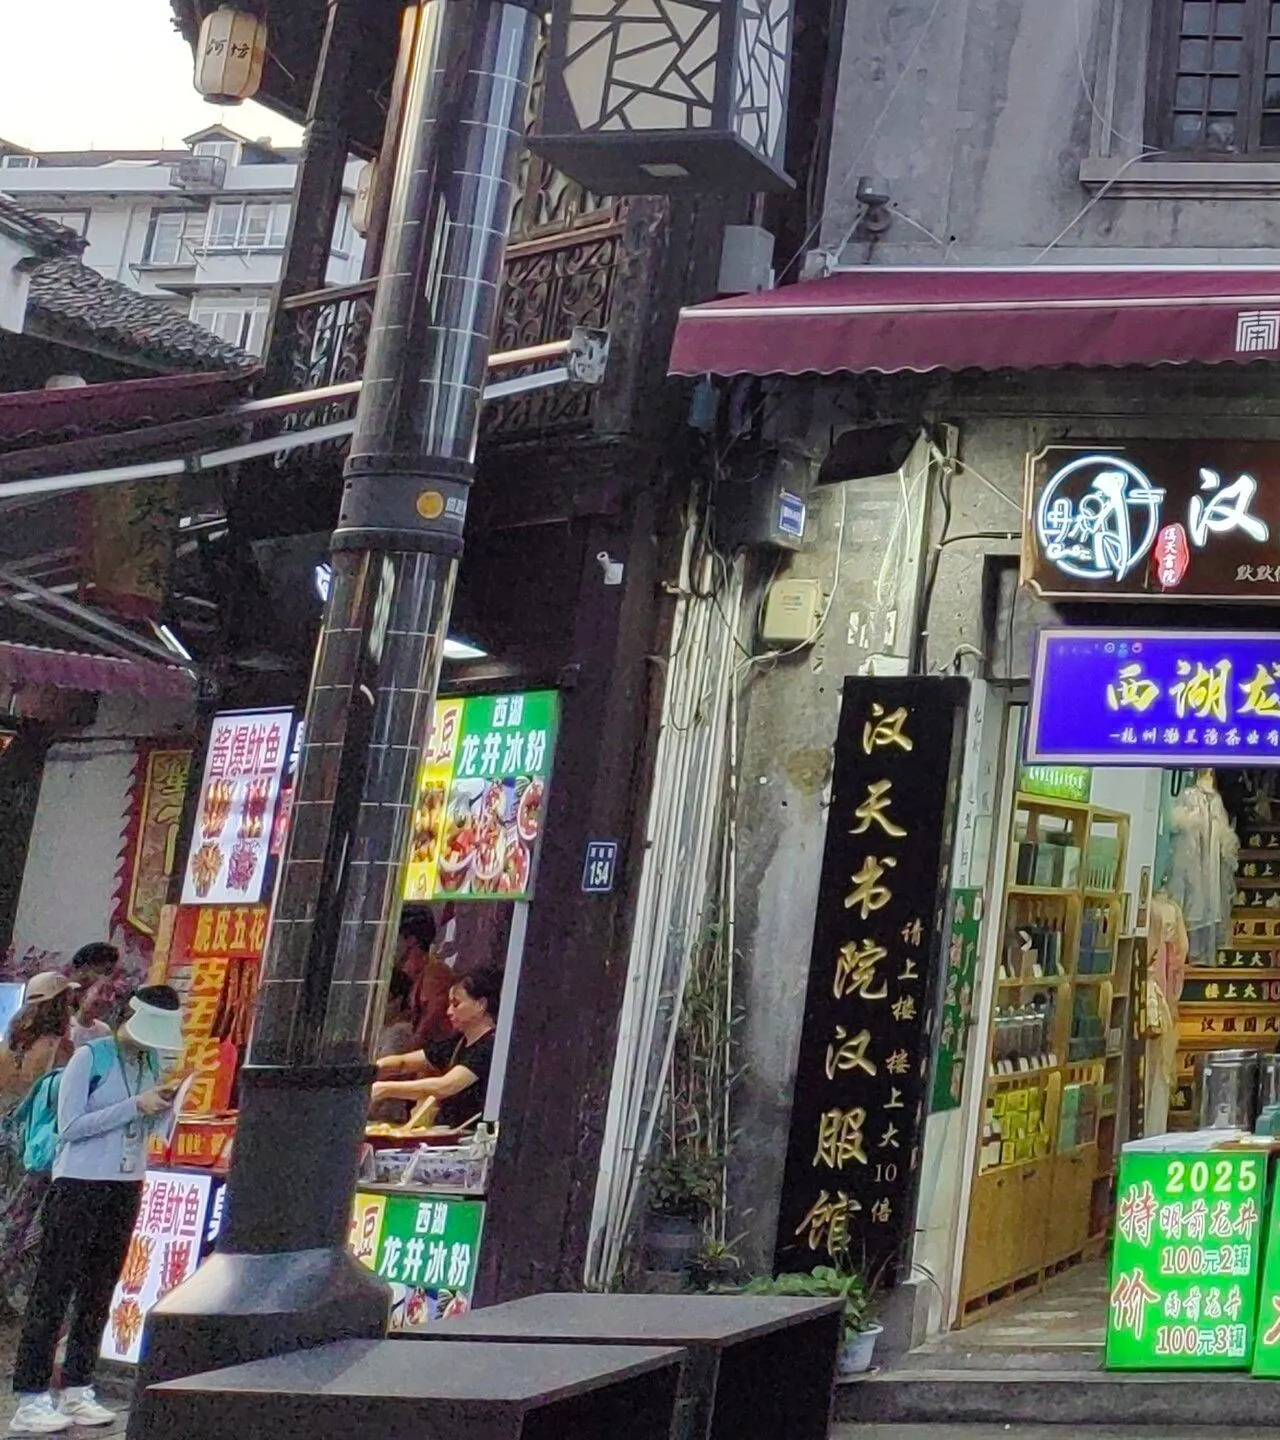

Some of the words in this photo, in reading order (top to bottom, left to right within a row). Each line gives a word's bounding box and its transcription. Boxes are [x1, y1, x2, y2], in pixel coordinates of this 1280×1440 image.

[492, 695, 524, 727] 西湖
[457, 729, 546, 775] 龙井冰粉
[590, 860, 609, 886] 154
[795, 703, 914, 1255] 汉天书院汉服馆
[890, 919, 924, 1022] 请上楼
[1201, 1016, 1280, 1034] 汉服国风
[1165, 1159, 1257, 1194] 2025
[415, 1201, 448, 1236] 西湖
[1160, 1199, 1259, 1240] 明前龙井
[377, 1235, 471, 1287] 龙井冰粉
[1110, 1180, 1160, 1342] 特价
[1160, 1245, 1251, 1276] 100元2罐
[1163, 1284, 1244, 1324] 雨前龙井
[1155, 1324, 1246, 1357] 100元3罐
